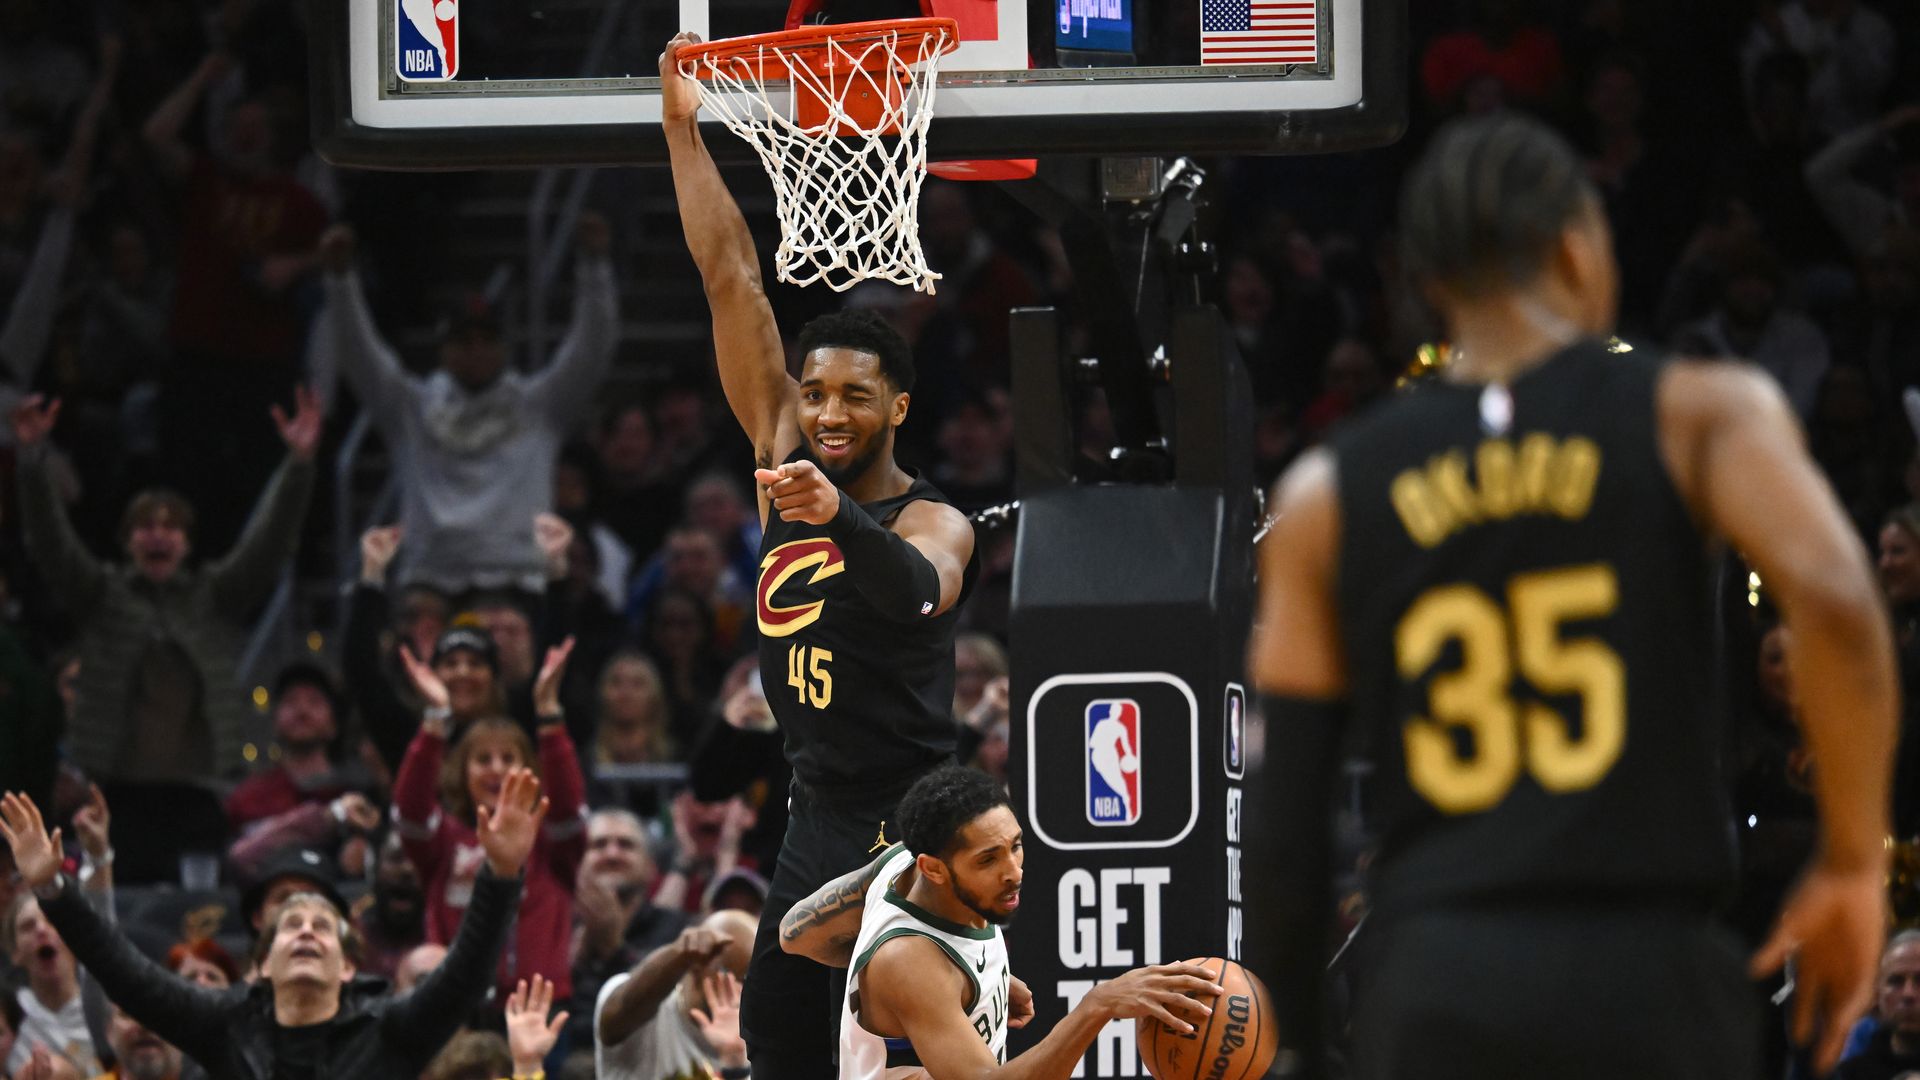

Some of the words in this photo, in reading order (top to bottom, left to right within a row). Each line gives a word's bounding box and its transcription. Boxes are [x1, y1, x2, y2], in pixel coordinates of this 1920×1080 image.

[405, 49, 435, 72] NBA
[1391, 432, 1601, 547] OKORO
[788, 642, 833, 709] 45
[1395, 564, 1627, 814] 35
[1095, 796, 1120, 818] NBA
[1058, 867, 1171, 969] GET
[1057, 979, 1152, 1078] TH
